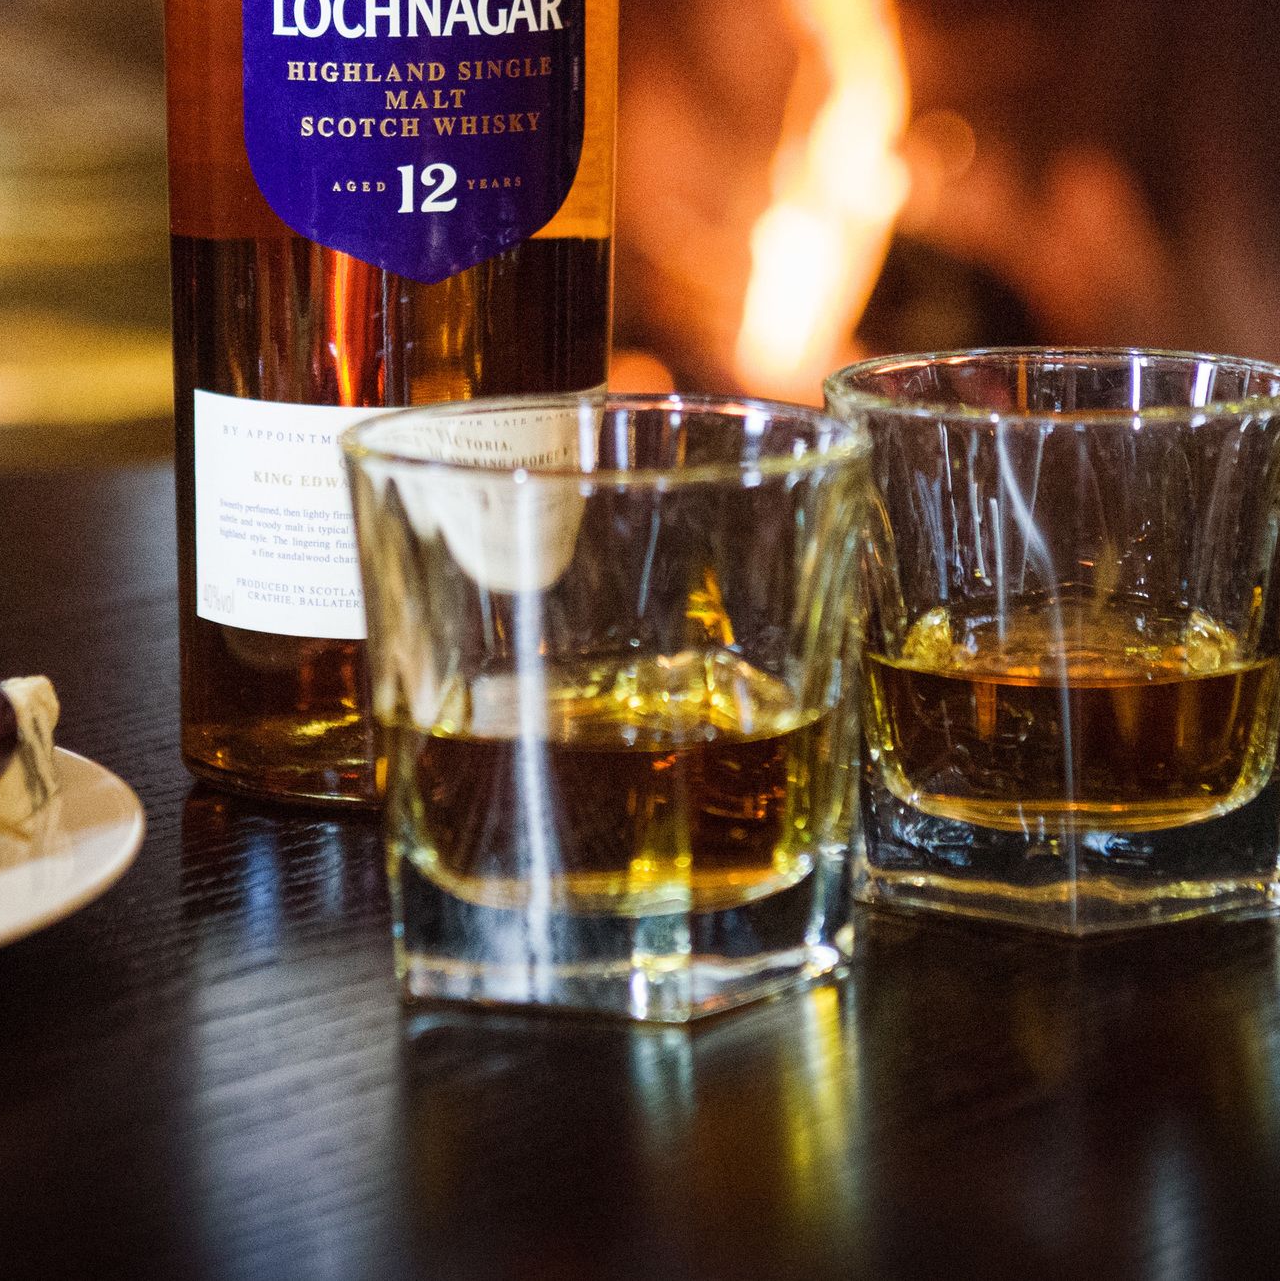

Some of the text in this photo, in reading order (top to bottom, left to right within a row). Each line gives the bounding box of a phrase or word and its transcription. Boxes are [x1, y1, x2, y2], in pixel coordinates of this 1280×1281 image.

[287, 61, 446, 82] HIGHLAND
[458, 56, 552, 80] SINGLE
[385, 89, 466, 110] MALT
[300, 111, 541, 138] SCOTCH WHISKY
[333, 162, 522, 214] AGED 12 YEARS
[223, 425, 239, 436] BY
[253, 471, 292, 486] KING
[283, 507, 300, 517] then
[303, 509, 330, 521] lightly
[240, 517, 253, 527] and
[256, 520, 282, 532] woody
[285, 523, 304, 532] malt
[307, 524, 315, 533] is
[318, 525, 349, 536] typical
[273, 535, 289, 546] The
[292, 538, 330, 550] lingering
[258, 549, 274, 559] fine
[277, 550, 331, 564] sandalwood
[236, 577, 290, 592] PRODUCED
[293, 586, 305, 594] IN
